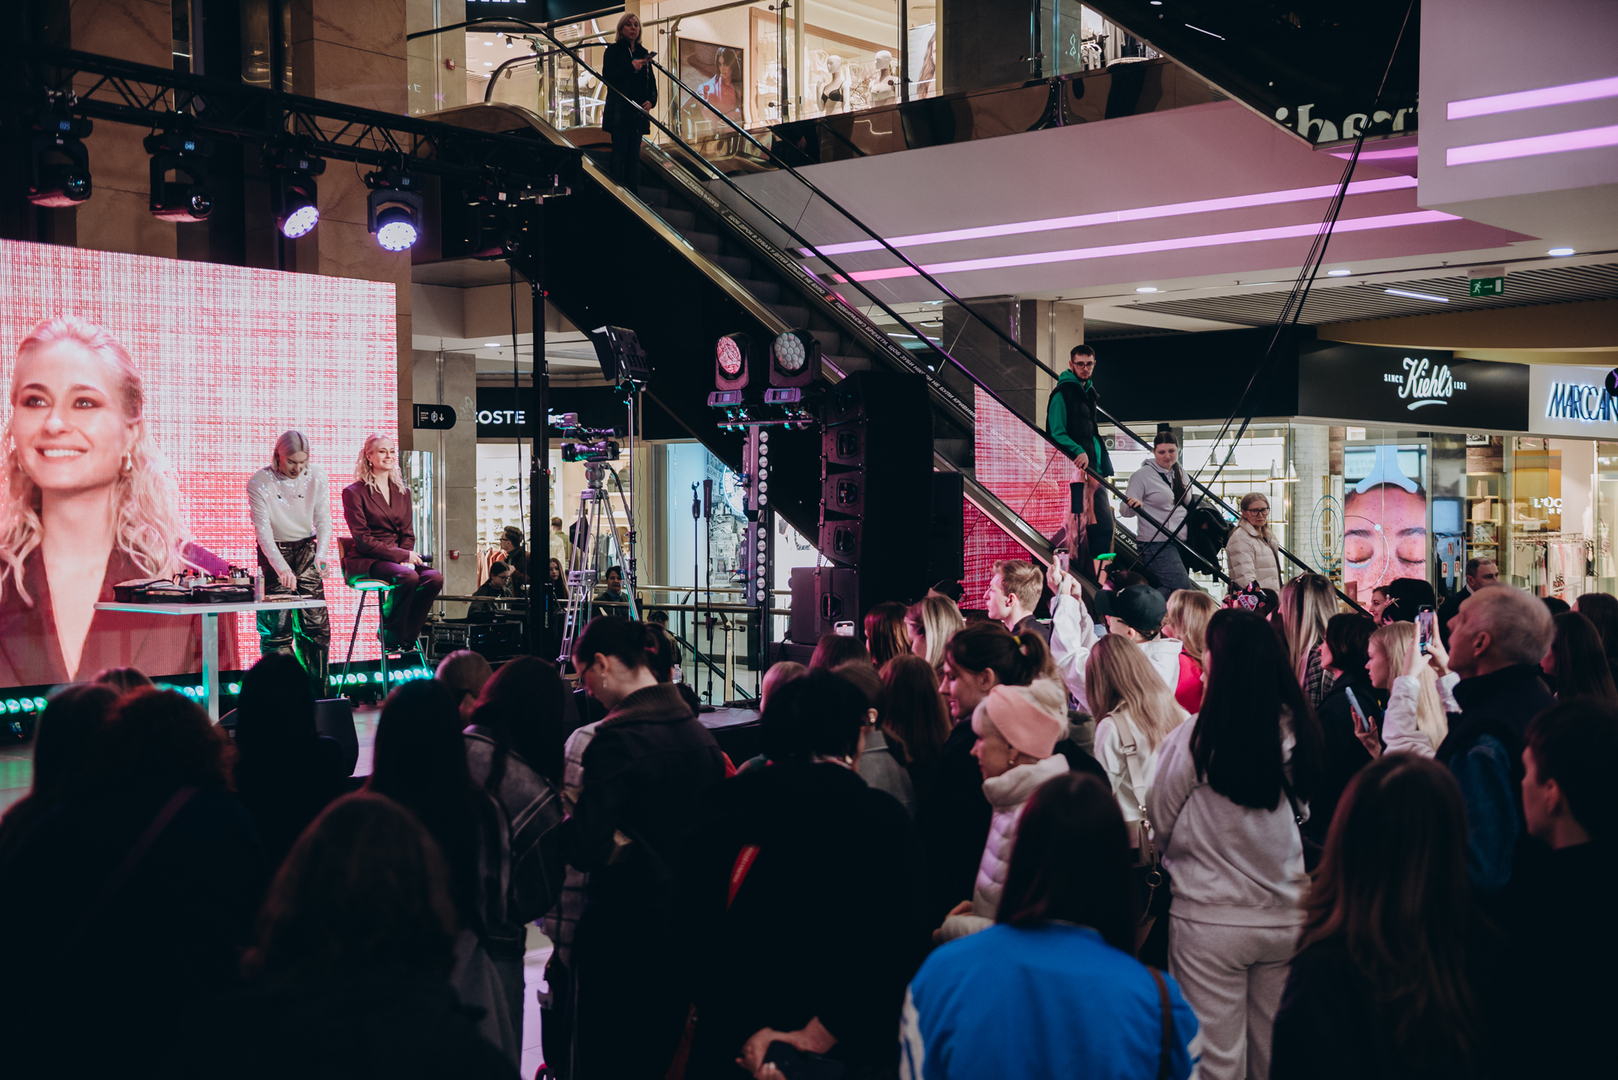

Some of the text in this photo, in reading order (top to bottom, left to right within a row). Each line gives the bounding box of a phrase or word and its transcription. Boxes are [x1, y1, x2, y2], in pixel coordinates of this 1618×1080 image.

[1383, 373, 1404, 384] SINCE
[1398, 357, 1453, 398] Kiehl's
[475, 410, 526, 425] OSTE
